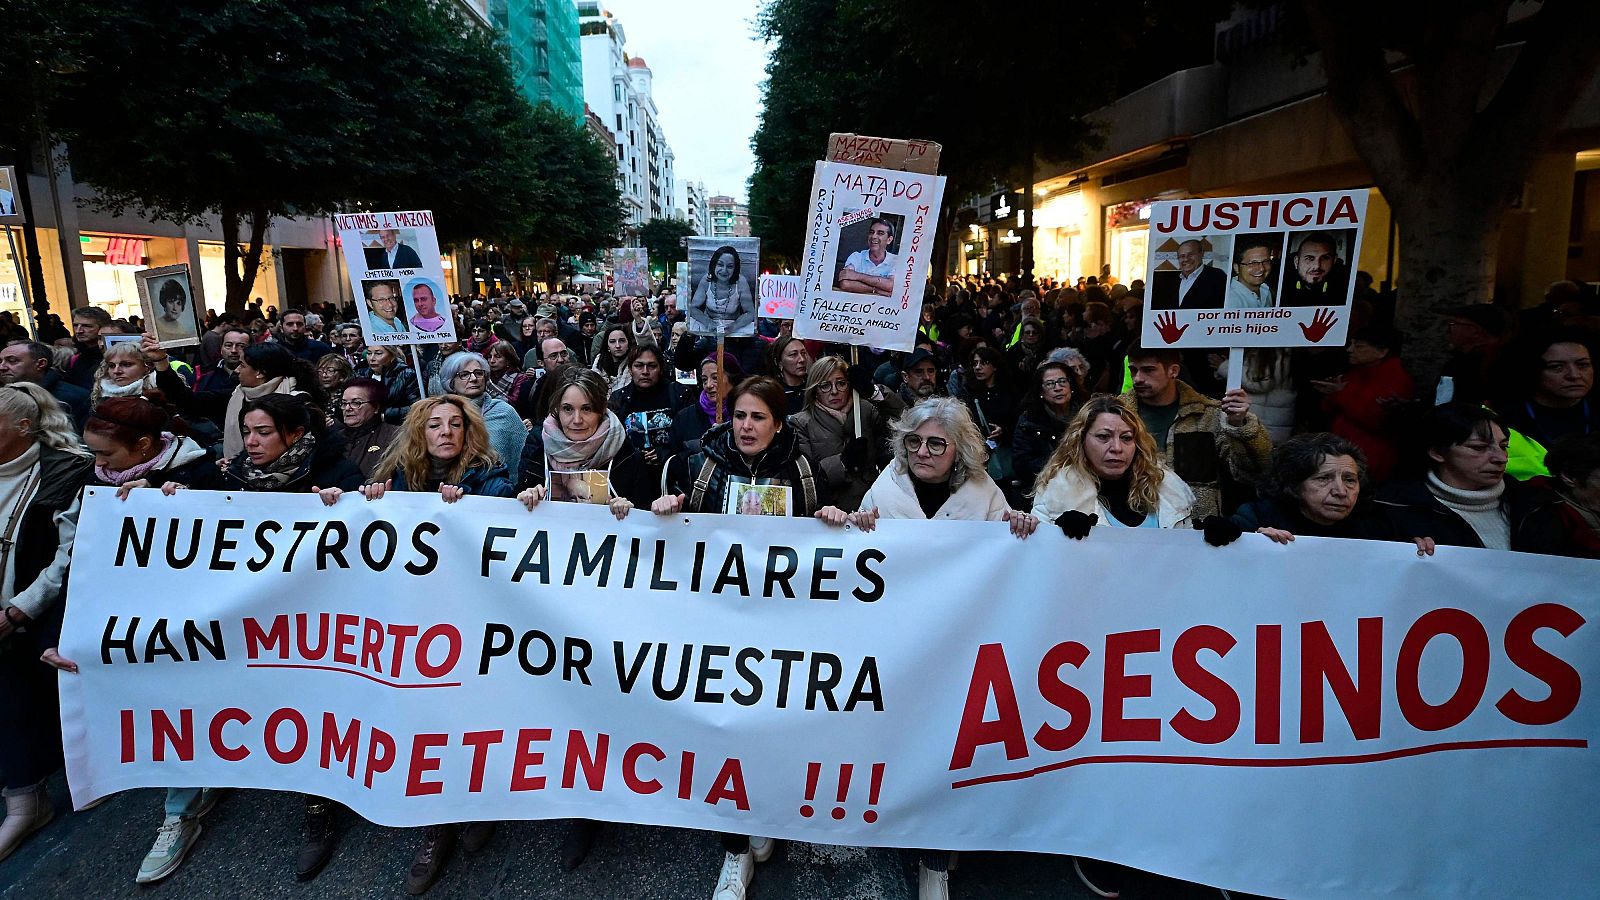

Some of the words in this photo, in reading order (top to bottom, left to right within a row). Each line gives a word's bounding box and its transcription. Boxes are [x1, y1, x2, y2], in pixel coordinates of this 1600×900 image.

[834, 173, 922, 200] MATADO
[861, 192, 883, 207] TÚ
[335, 214, 379, 230] VICTIMAS
[382, 213, 392, 228] de
[1156, 195, 1359, 233] JUSTICIA
[813, 297, 876, 314] FALLECIÓ
[877, 306, 900, 316] CON
[1197, 311, 1220, 321] por
[1223, 310, 1240, 319] mi
[1244, 309, 1292, 319] marido
[810, 312, 863, 326] NUESTROS
[865, 319, 901, 331] AMADOS
[1206, 326, 1215, 336] y
[1218, 324, 1242, 333] mis
[1246, 324, 1279, 335] hijos
[115, 517, 440, 576] NUESTROS
[481, 526, 887, 603] FAMILIARES
[101, 615, 227, 665] HAN
[244, 613, 462, 679] MUERTO
[479, 622, 593, 687] POR
[613, 640, 885, 713] VUESTRA
[948, 602, 1587, 772] ASESINOS
[120, 708, 749, 812] INCOMPETENCIA
[799, 762, 886, 824] !!!
